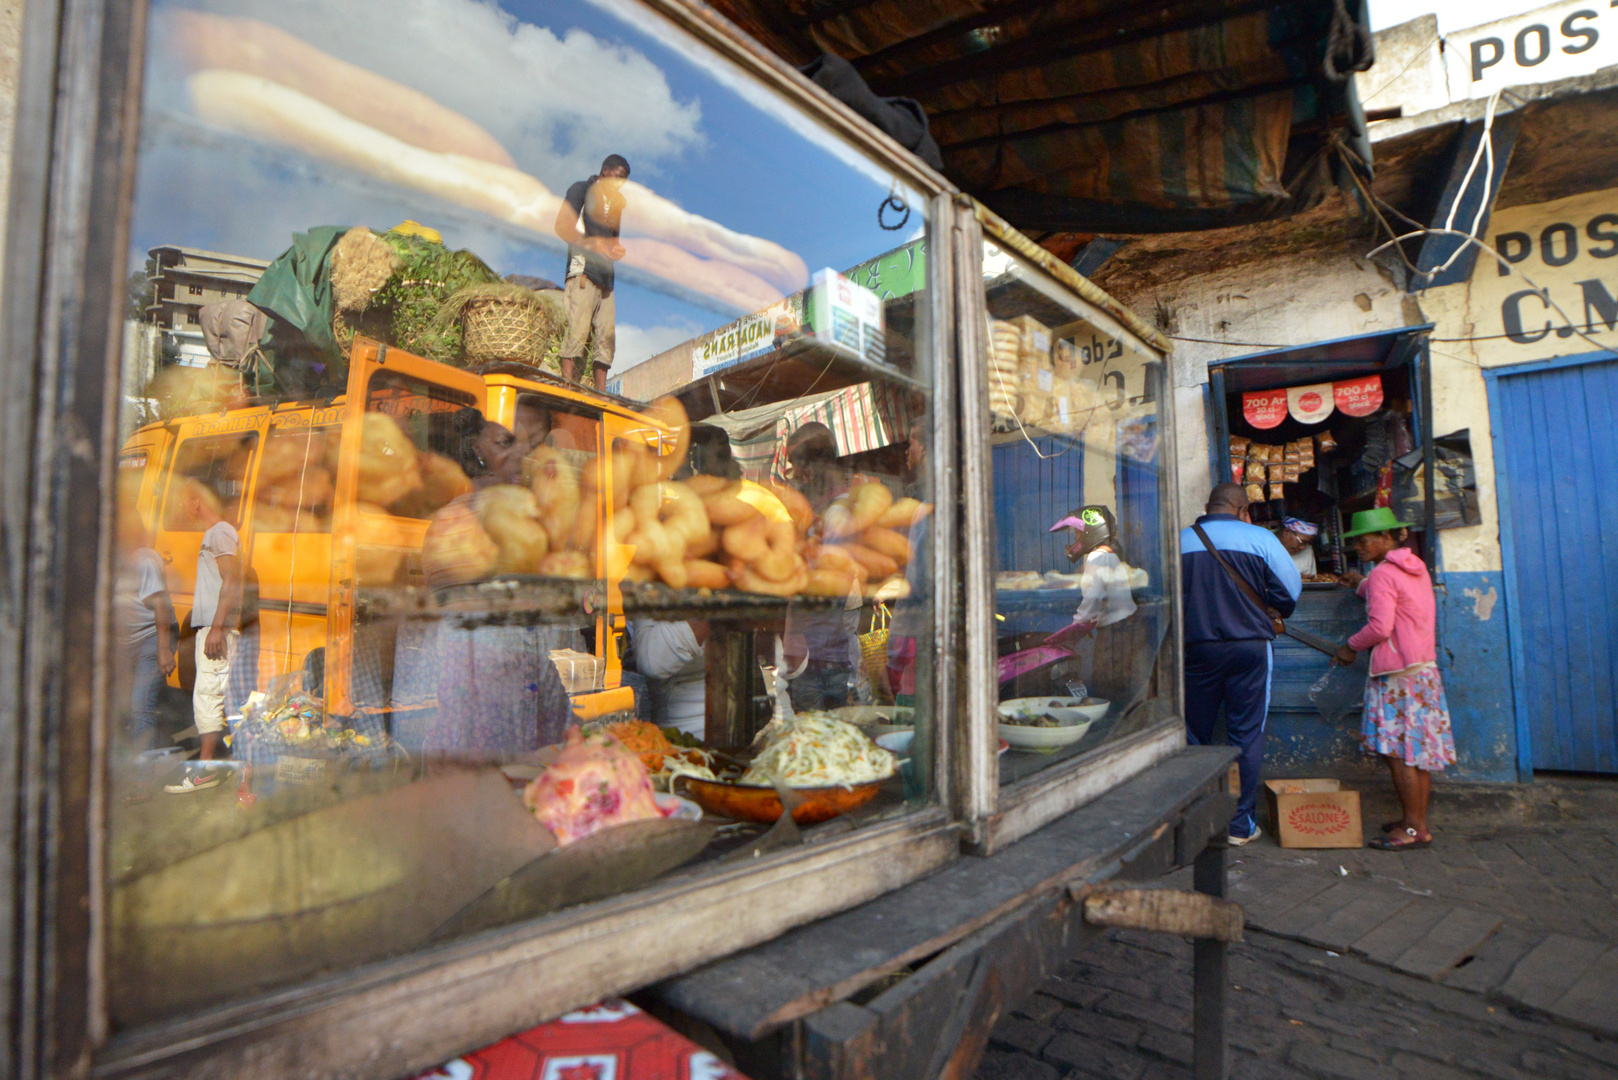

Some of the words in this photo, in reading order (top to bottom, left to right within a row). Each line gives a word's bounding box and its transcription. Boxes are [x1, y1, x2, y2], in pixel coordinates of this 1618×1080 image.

[1470, 0, 1618, 82] POS
[1336, 385, 1361, 397] 700
[1364, 383, 1378, 393] Ar
[1246, 398, 1268, 408] 700
[1271, 396, 1285, 406] Ar
[1298, 811, 1340, 825] SALONE
